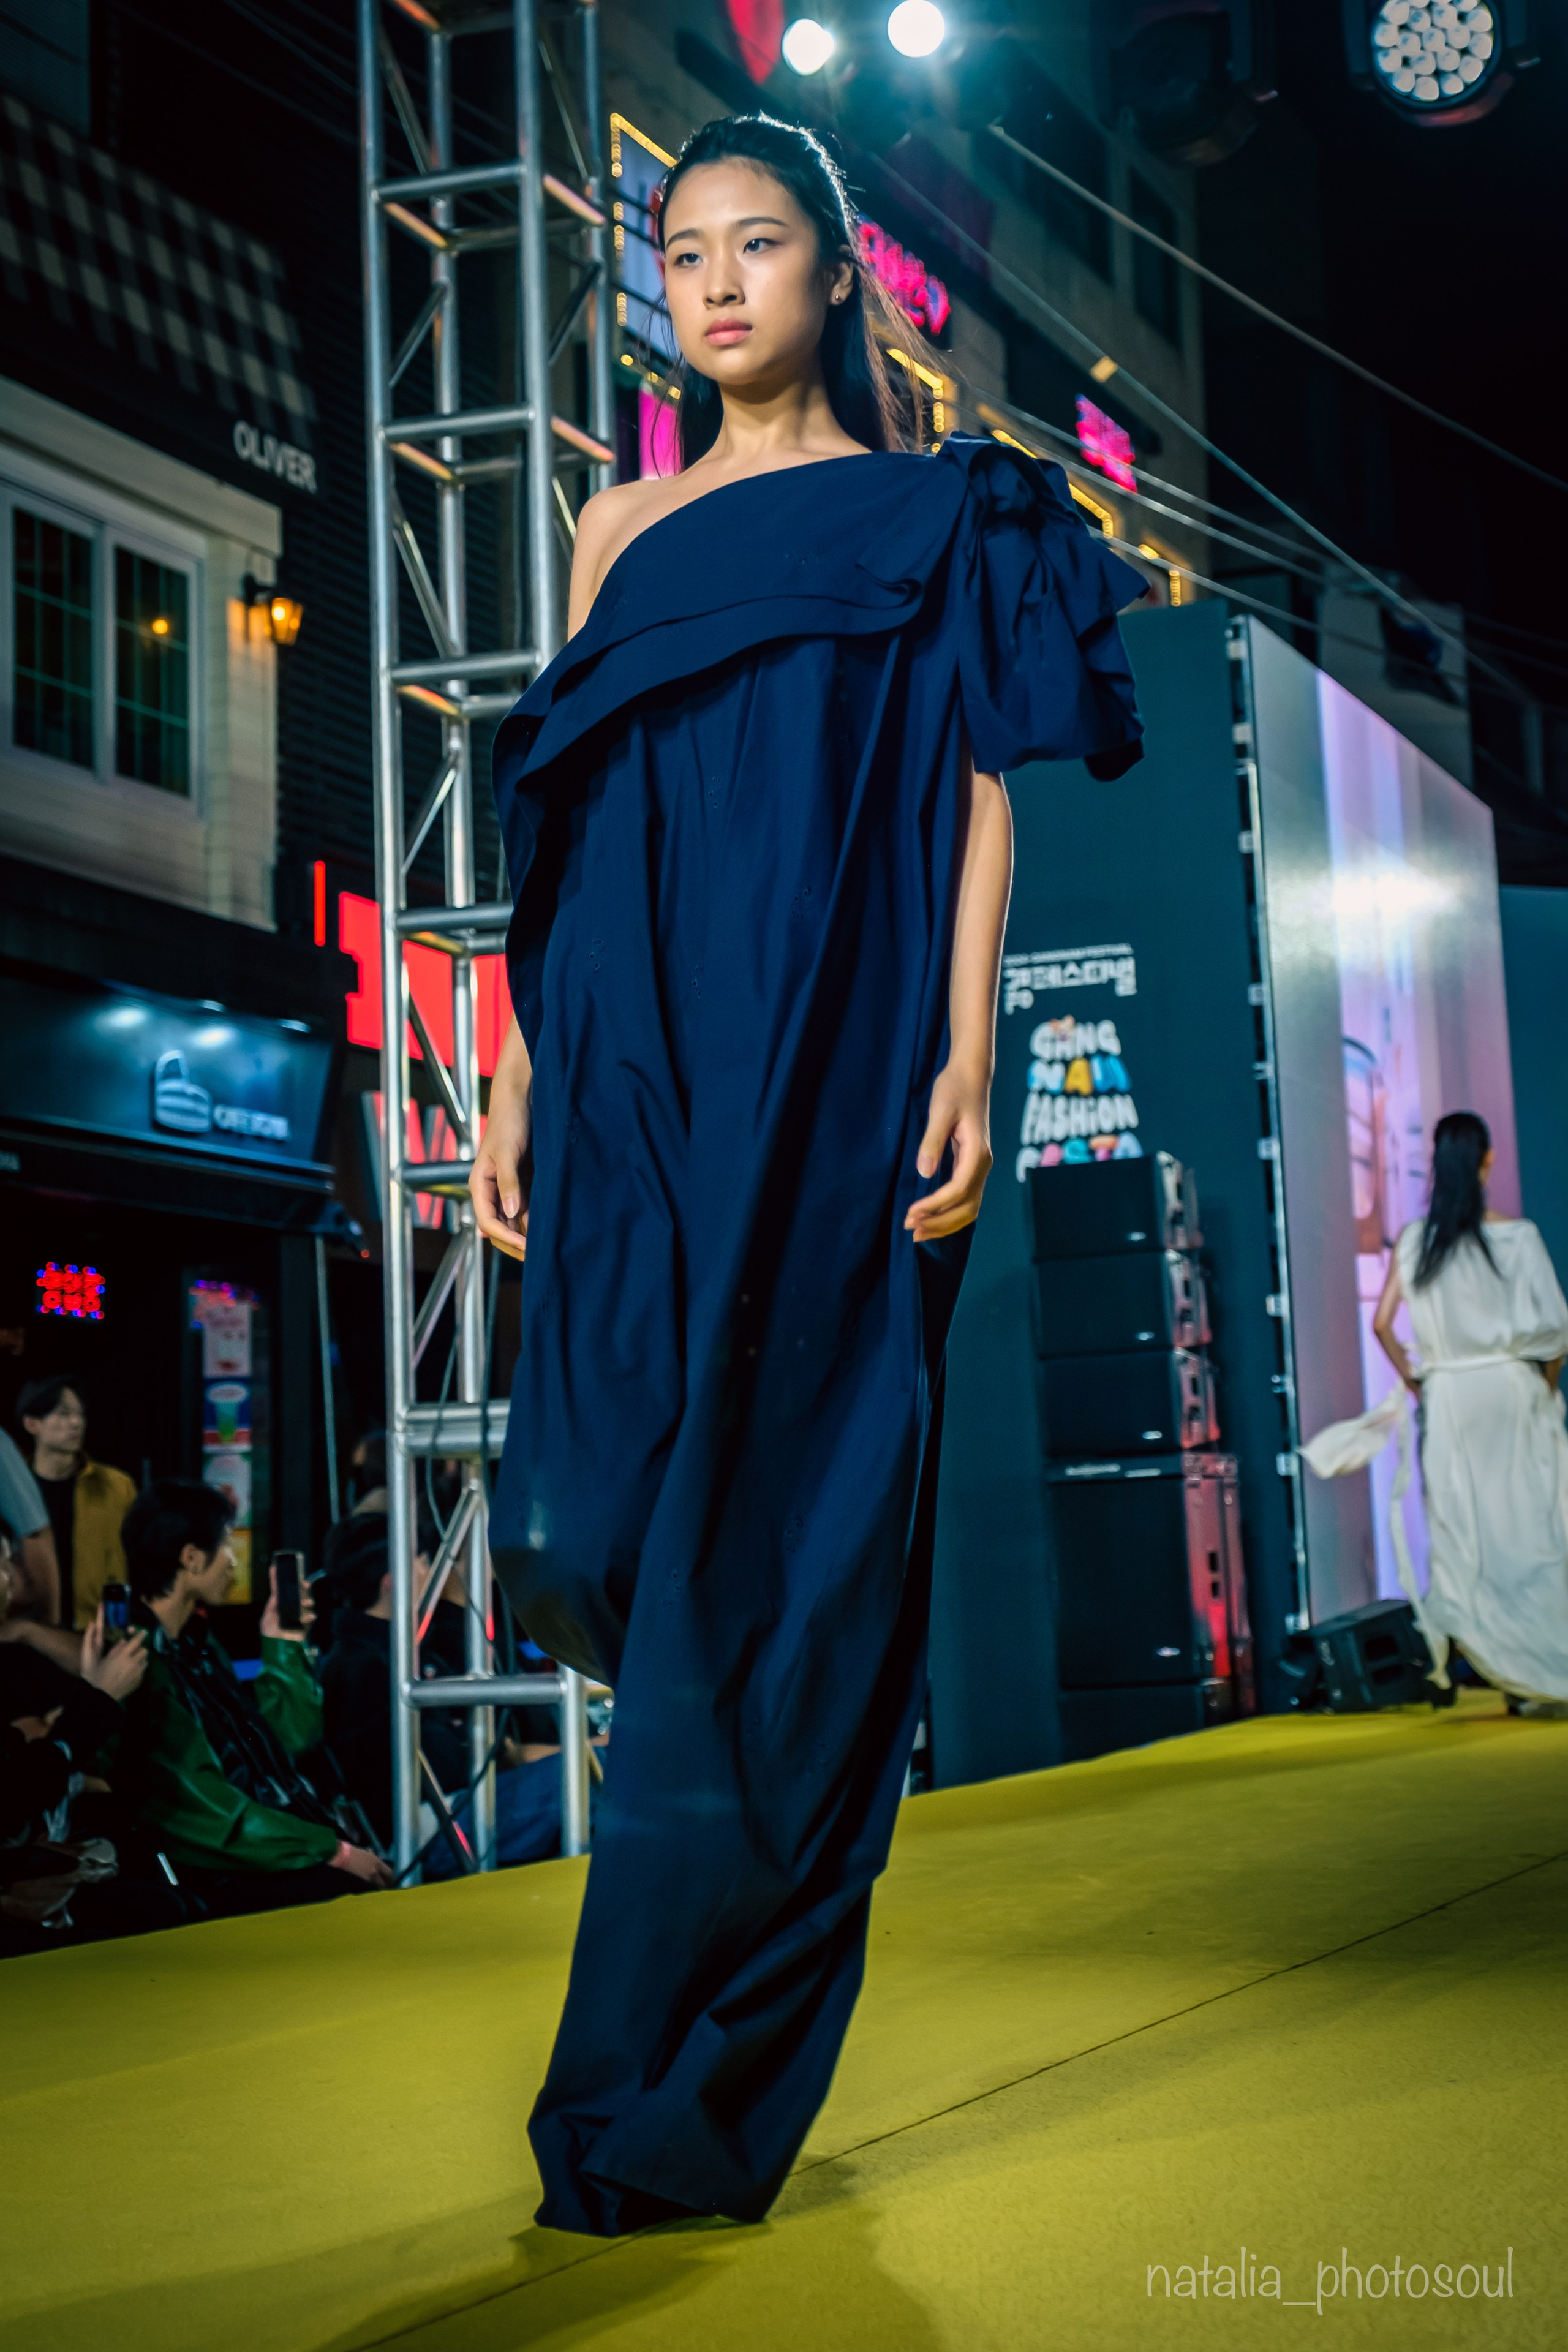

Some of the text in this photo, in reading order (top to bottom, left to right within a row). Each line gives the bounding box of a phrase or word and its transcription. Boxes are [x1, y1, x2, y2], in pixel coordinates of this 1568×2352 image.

[233, 420, 317, 494] OLIVER
[1030, 1019, 1121, 1061] GANG
[1027, 1055, 1131, 1095] NAM
